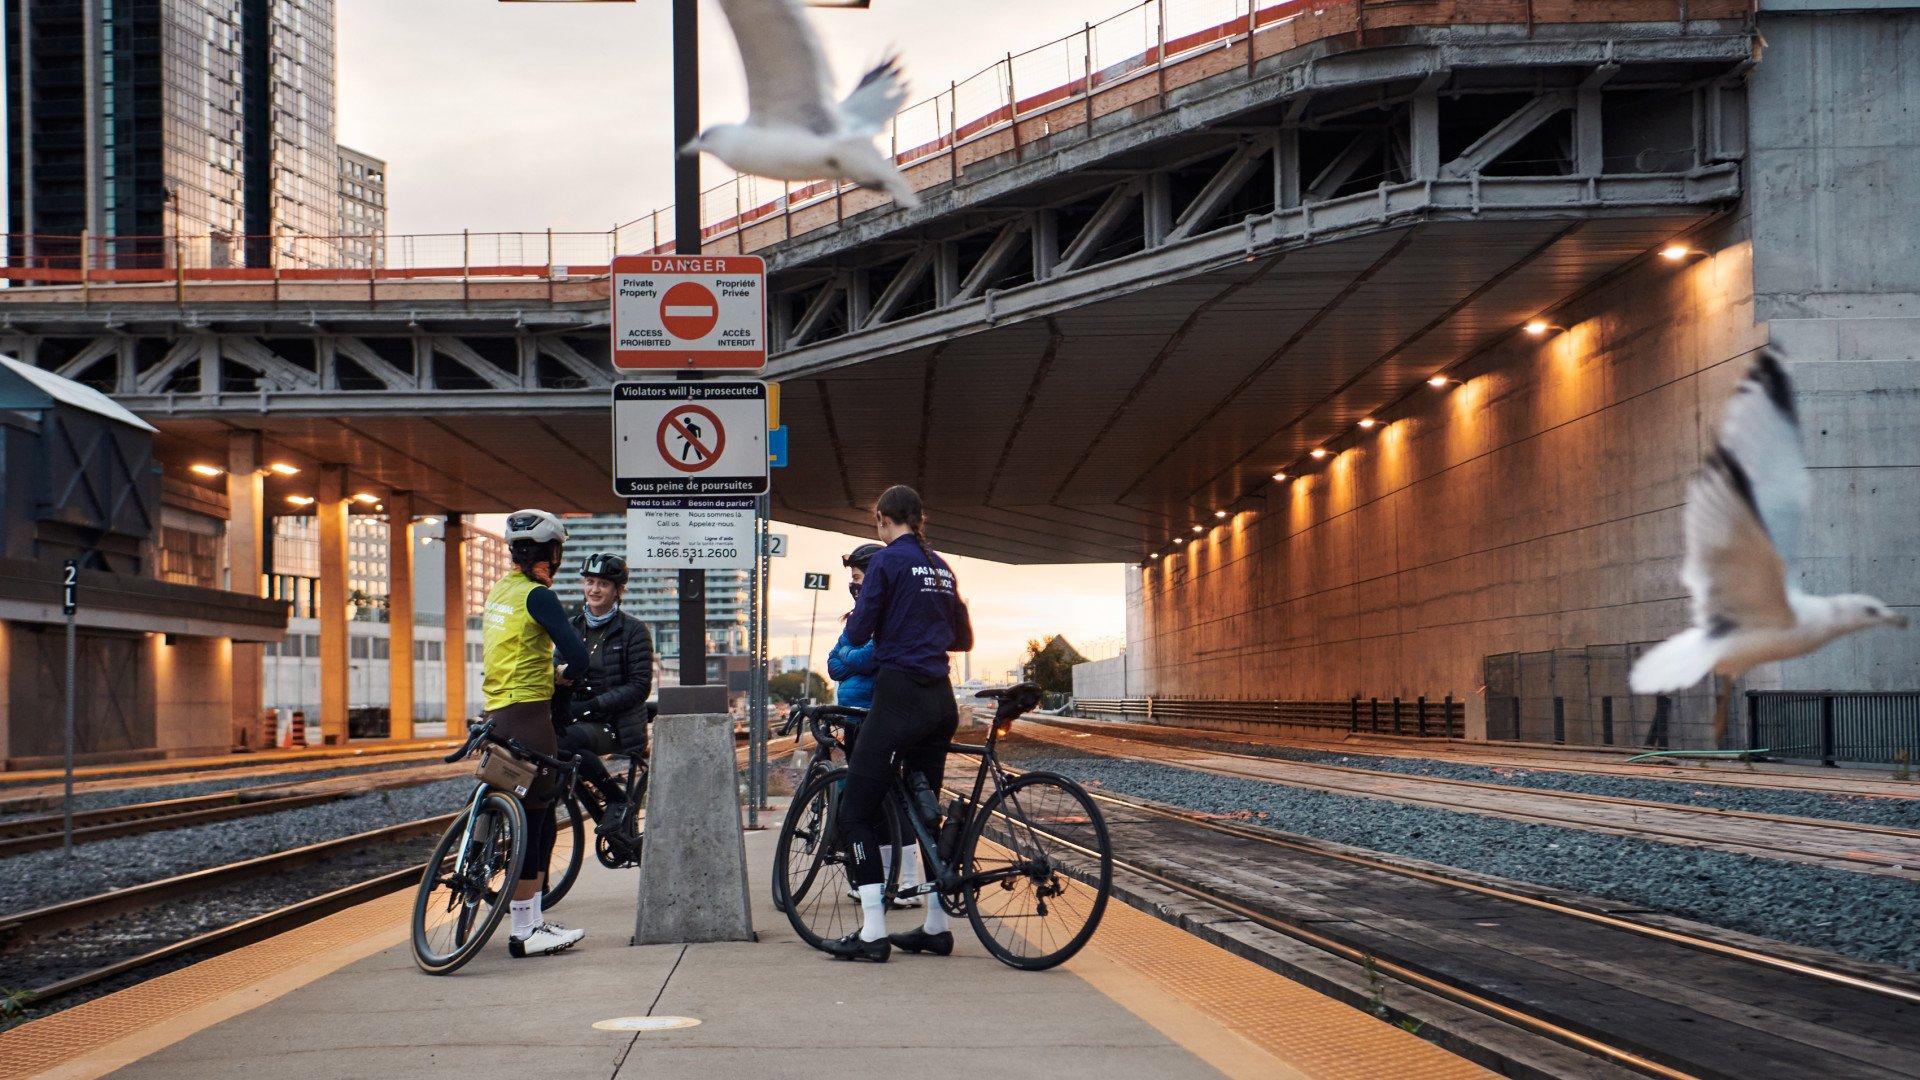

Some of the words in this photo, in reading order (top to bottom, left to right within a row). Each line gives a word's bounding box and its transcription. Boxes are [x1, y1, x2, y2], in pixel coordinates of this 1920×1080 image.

[651, 259, 726, 272] DANGER
[623, 279, 654, 287] Private
[716, 279, 756, 289] Propriété
[619, 289, 658, 298] Property
[722, 289, 750, 297] Privée
[620, 339, 672, 347] PROHIBITED
[717, 339, 756, 347] INTERDIT
[621, 386, 667, 396] Violators
[669, 386, 687, 395] will
[689, 386, 702, 396] be
[704, 385, 759, 397] prosecuted
[630, 482, 654, 491] Sous
[656, 481, 684, 492] peine
[686, 480, 699, 490] de
[701, 480, 753, 492] poursuites
[726, 500, 754, 508] parler?
[771, 537, 781, 554] 2
[646, 548, 738, 558] 1.866.531.2600
[911, 566, 929, 576] PAS
[808, 574, 826, 588] 2L
[924, 577, 953, 589] STUIOS
